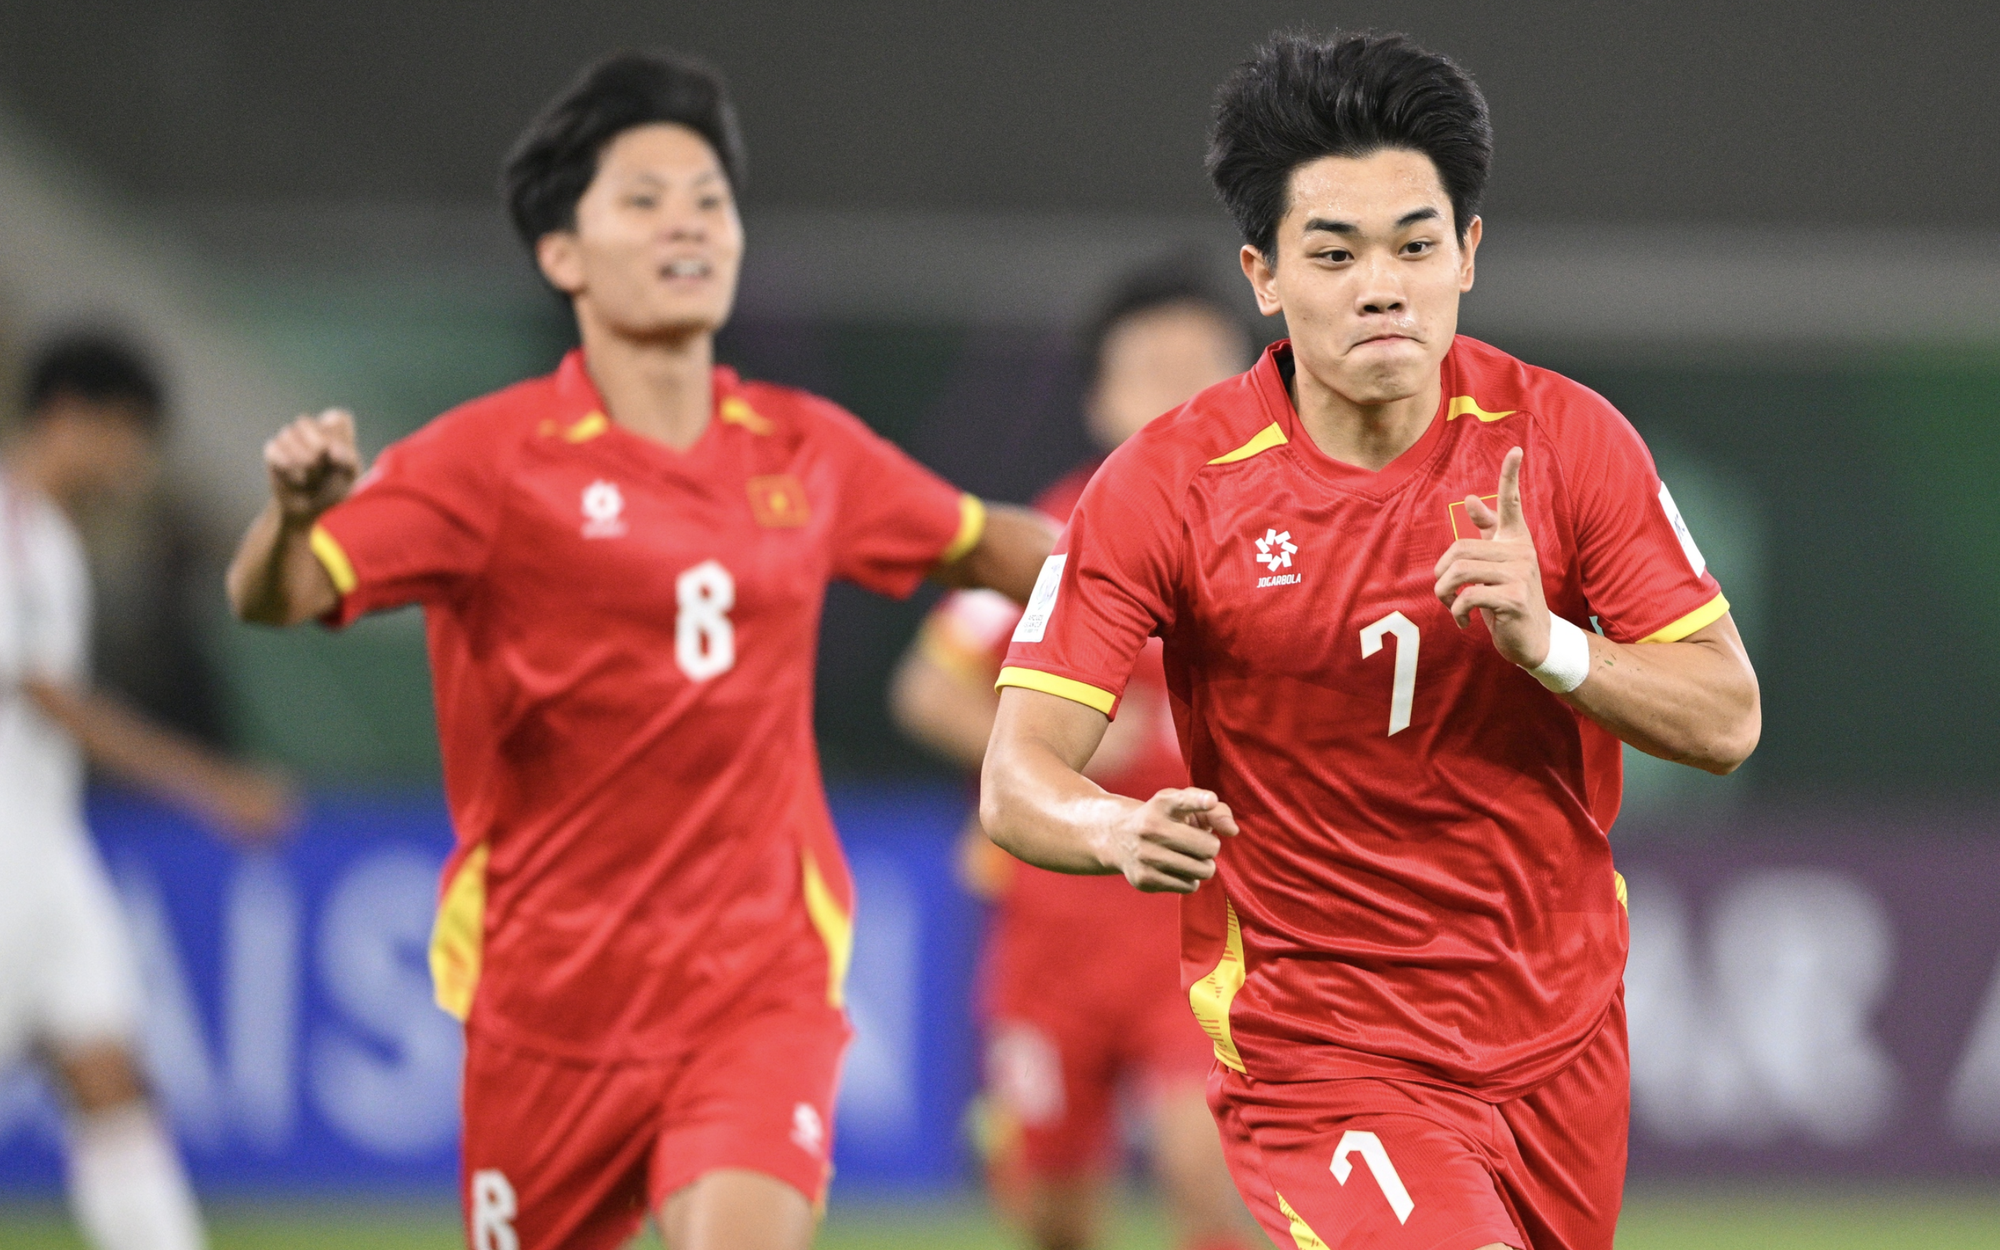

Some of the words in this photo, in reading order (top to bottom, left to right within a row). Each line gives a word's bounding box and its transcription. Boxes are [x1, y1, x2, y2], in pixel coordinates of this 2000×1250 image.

[675, 559, 735, 682] 8
[1256, 572, 1302, 589] JOGARBOLA
[1360, 610, 1420, 738] 7
[472, 1169, 520, 1250] 8
[1329, 1129, 1415, 1226] 7
